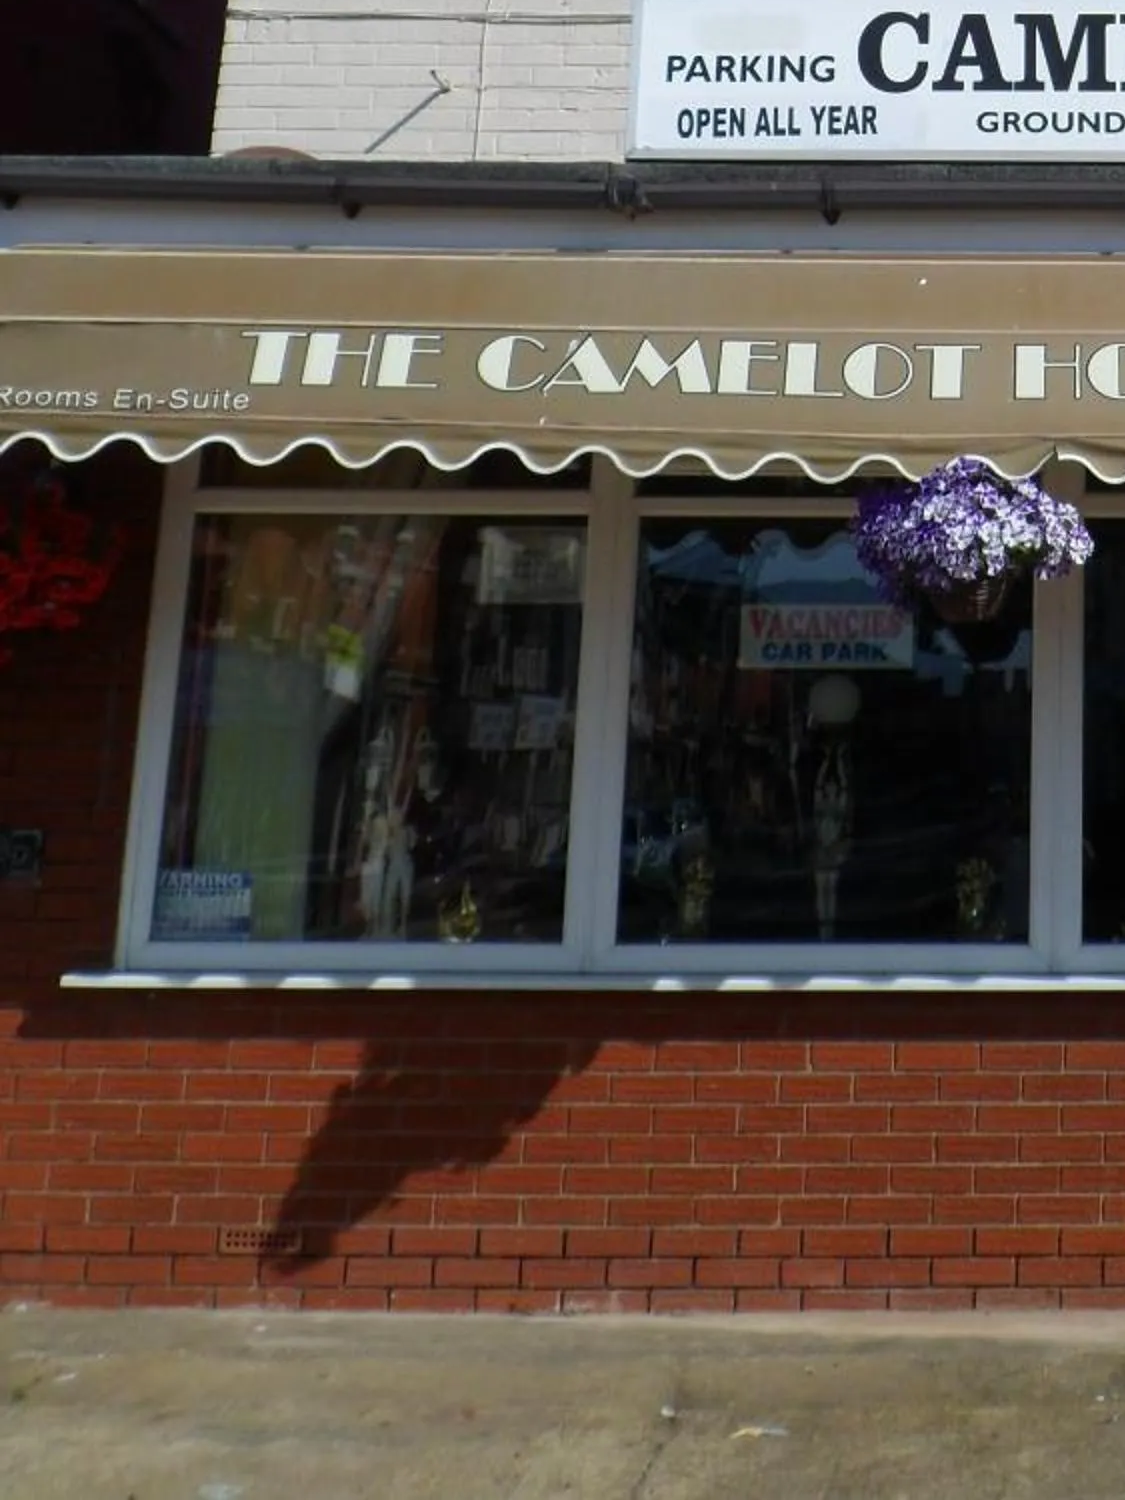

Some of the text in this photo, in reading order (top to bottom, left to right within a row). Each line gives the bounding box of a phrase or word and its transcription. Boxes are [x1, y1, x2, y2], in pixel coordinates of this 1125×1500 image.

[665, 54, 836, 84] PARKING
[676, 105, 879, 139] OPEN ALL YEAR
[241, 330, 442, 388] THE
[476, 334, 982, 400] CAMELOT
[112, 387, 250, 411] En-Suite
[748, 608, 904, 639] VACANCIES
[761, 642, 888, 662] CAR PARK
